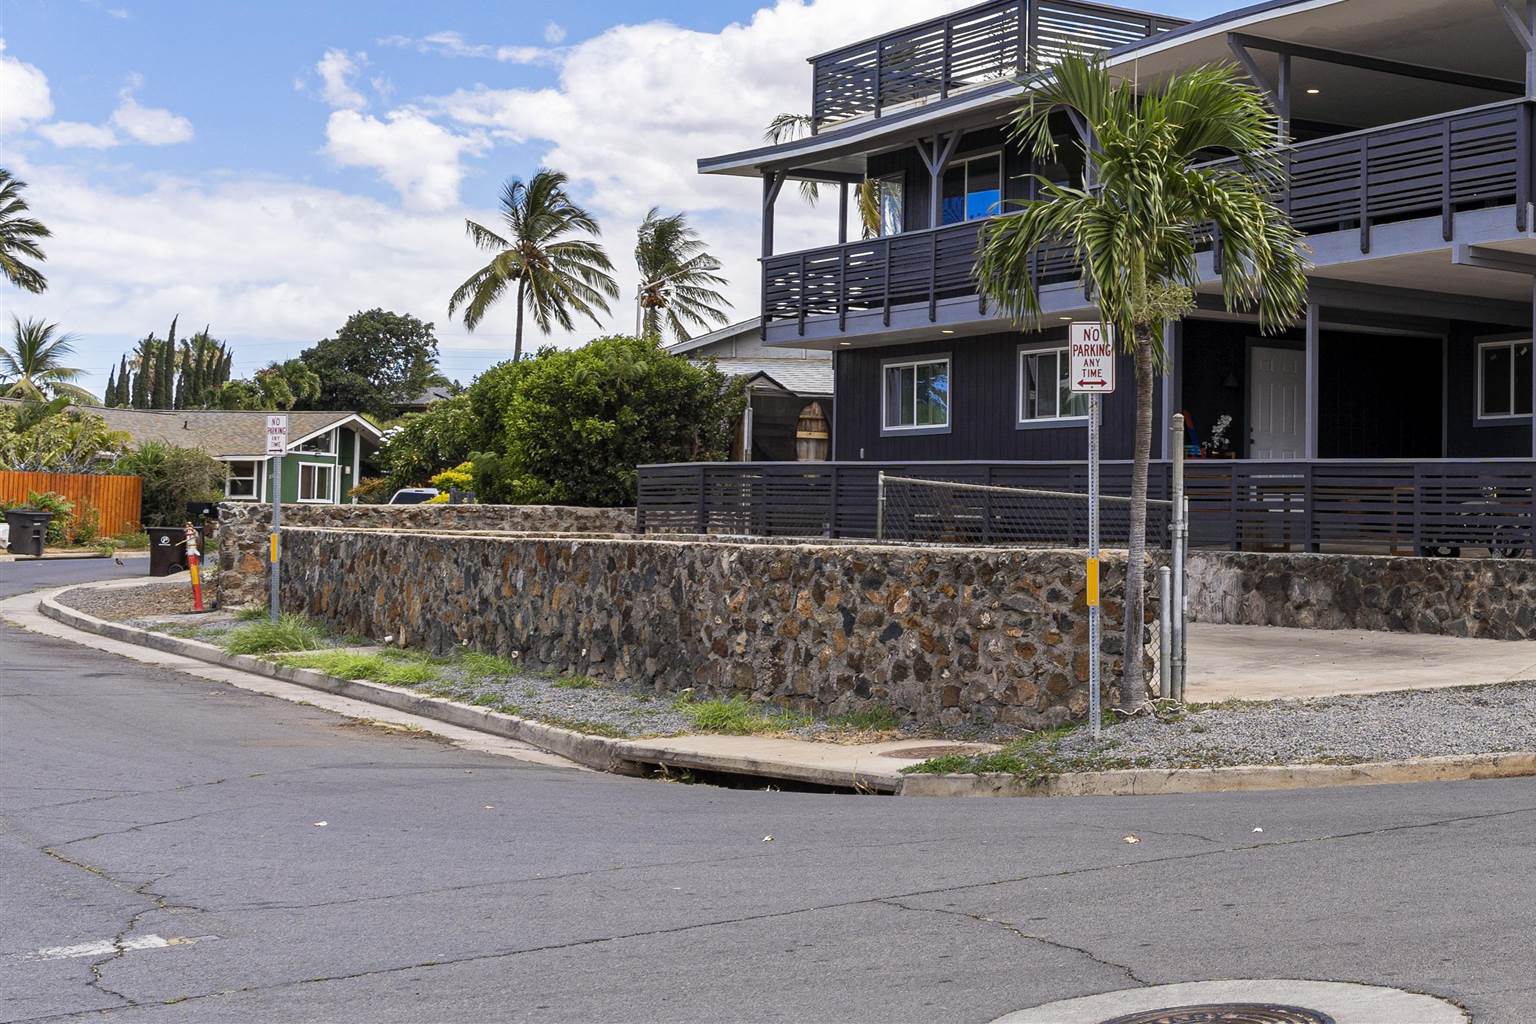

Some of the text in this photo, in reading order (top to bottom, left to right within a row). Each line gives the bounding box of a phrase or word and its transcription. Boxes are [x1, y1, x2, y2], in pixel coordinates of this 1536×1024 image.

[1083, 328, 1100, 342] NO
[1073, 344, 1111, 356] PARKING
[1083, 358, 1100, 366] ANY
[1082, 369, 1102, 378] TIME
[272, 418, 280, 426] NO
